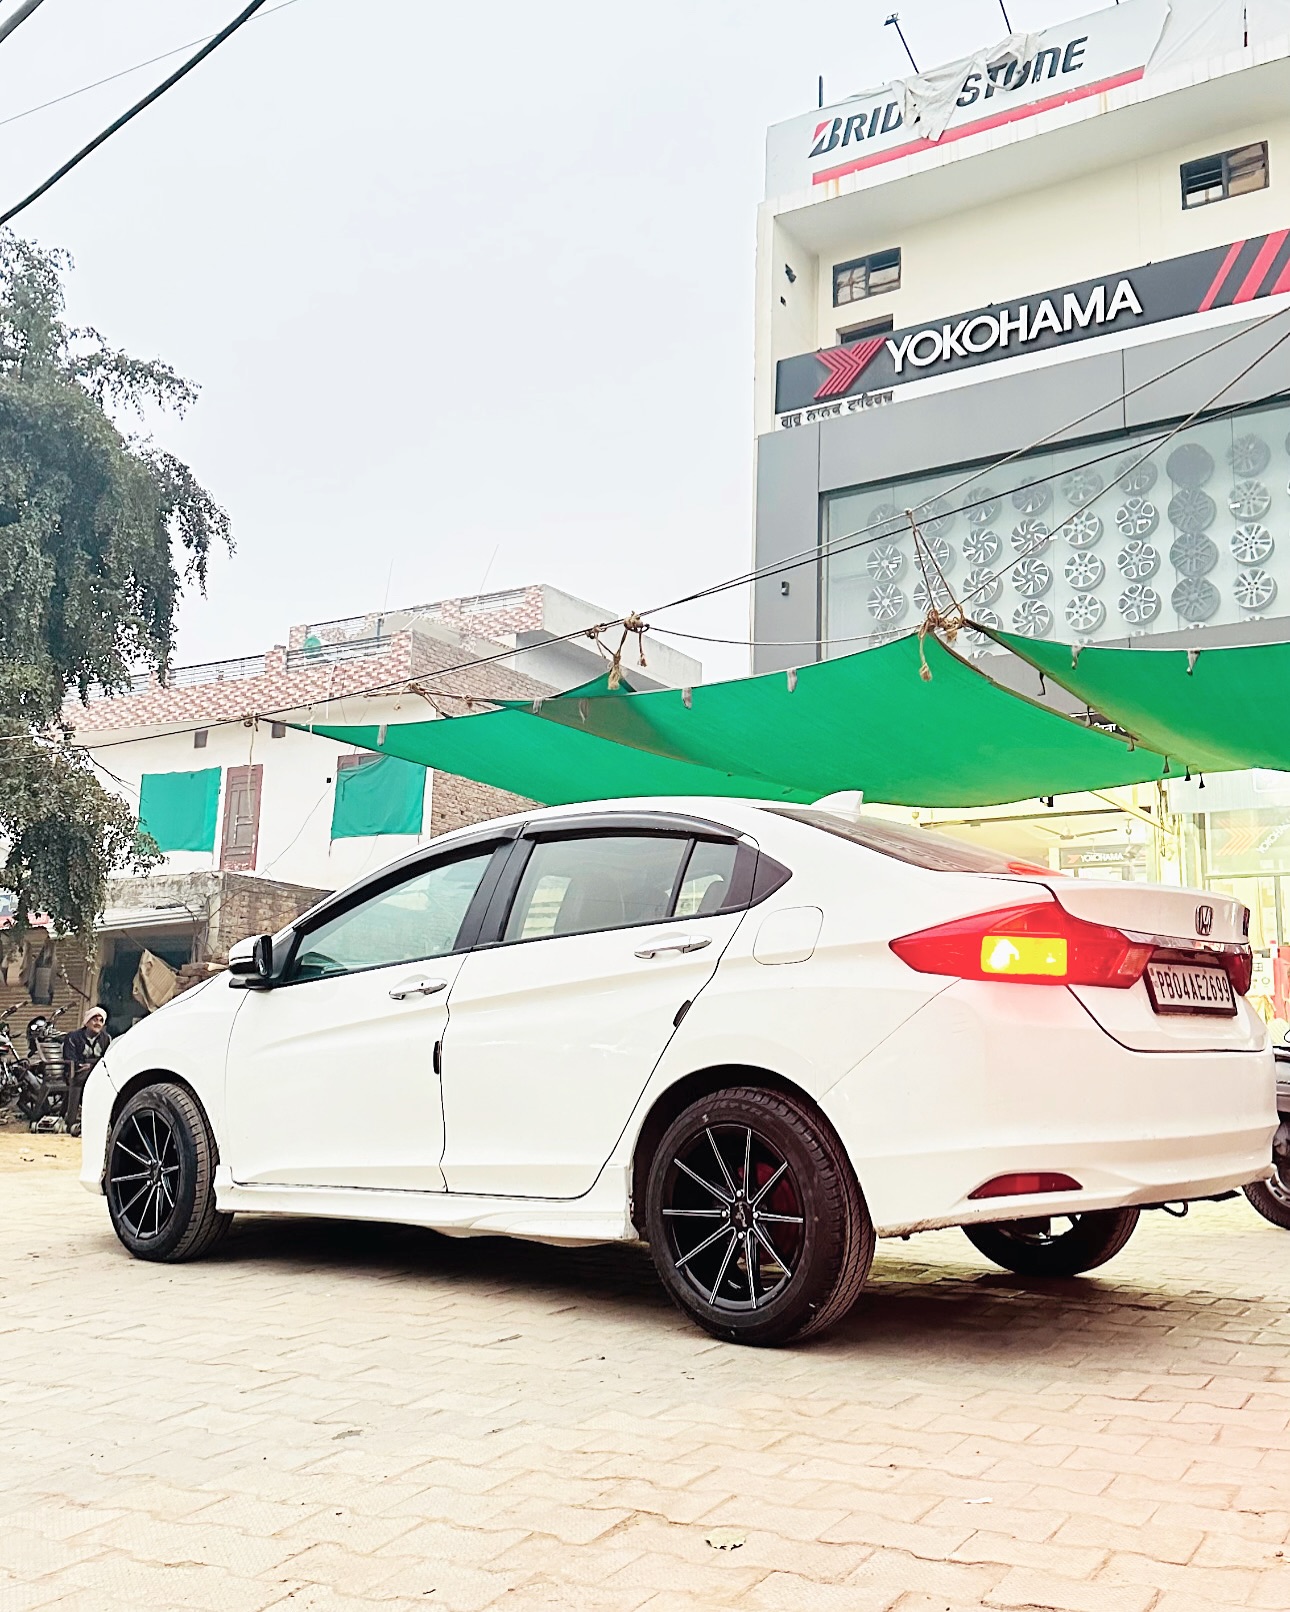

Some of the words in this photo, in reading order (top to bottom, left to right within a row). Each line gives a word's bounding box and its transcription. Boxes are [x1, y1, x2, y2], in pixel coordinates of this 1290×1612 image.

[808, 36, 1088, 158] BRIDSTONE
[886, 280, 1143, 374] YOKOHAMA
[806, 402, 843, 422] ਨਾਨਕ
[1156, 969, 1231, 1003] PB04AE2699
